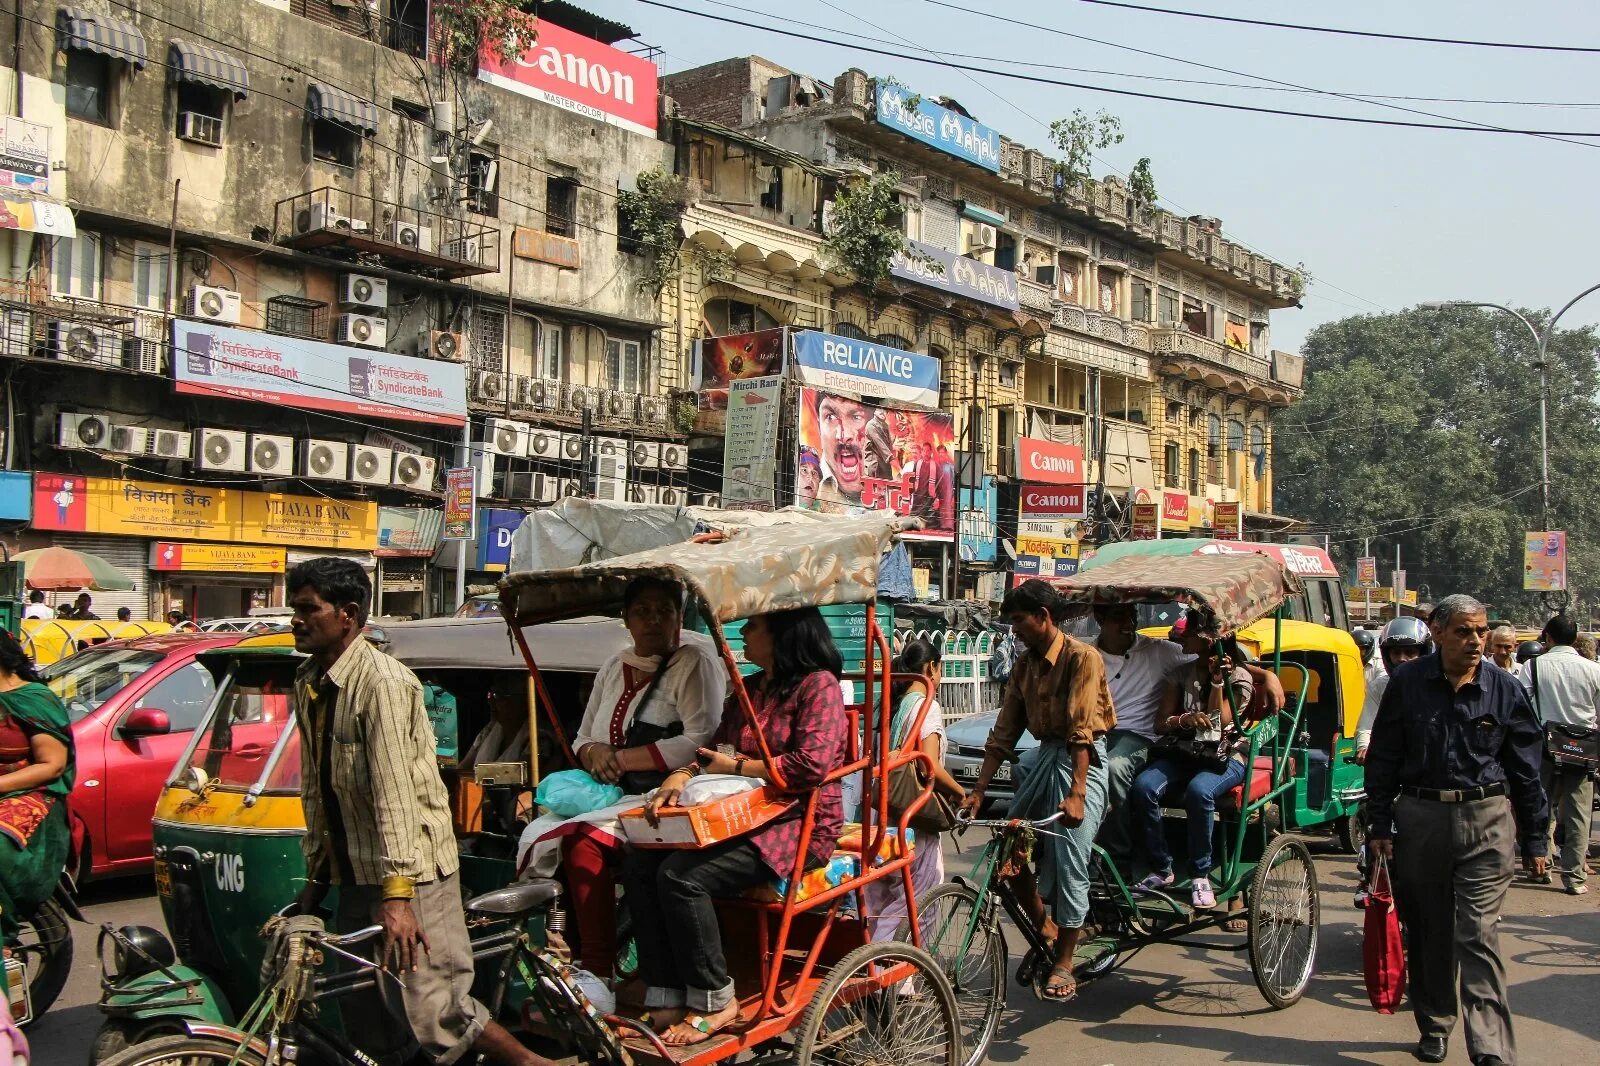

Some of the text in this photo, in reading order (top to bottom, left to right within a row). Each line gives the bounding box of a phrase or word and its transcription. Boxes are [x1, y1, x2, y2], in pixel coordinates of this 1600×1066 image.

[543, 92, 602, 119] MASTER COLOR
[939, 112, 998, 164] Mahal
[950, 256, 1017, 304] Mahal
[221, 357, 299, 380] SyndicateBank
[377, 379, 444, 399] SyndicateBank
[732, 379, 778, 391] Mirchi Ram
[824, 372, 889, 396] Entertainment
[1030, 451, 1075, 474] Canon
[123, 483, 213, 508] विजया बैंक
[1026, 493, 1079, 506] Canon
[265, 499, 351, 521] VIJAYA BANK
[1027, 522, 1053, 533] SAMSUNG
[210, 550, 236, 558] VIJAYA
[238, 551, 256, 559] BANK
[1025, 539, 1053, 555] Kodak
[1057, 563, 1076, 571] SONY
[354, 1049, 379, 1066] NEE
